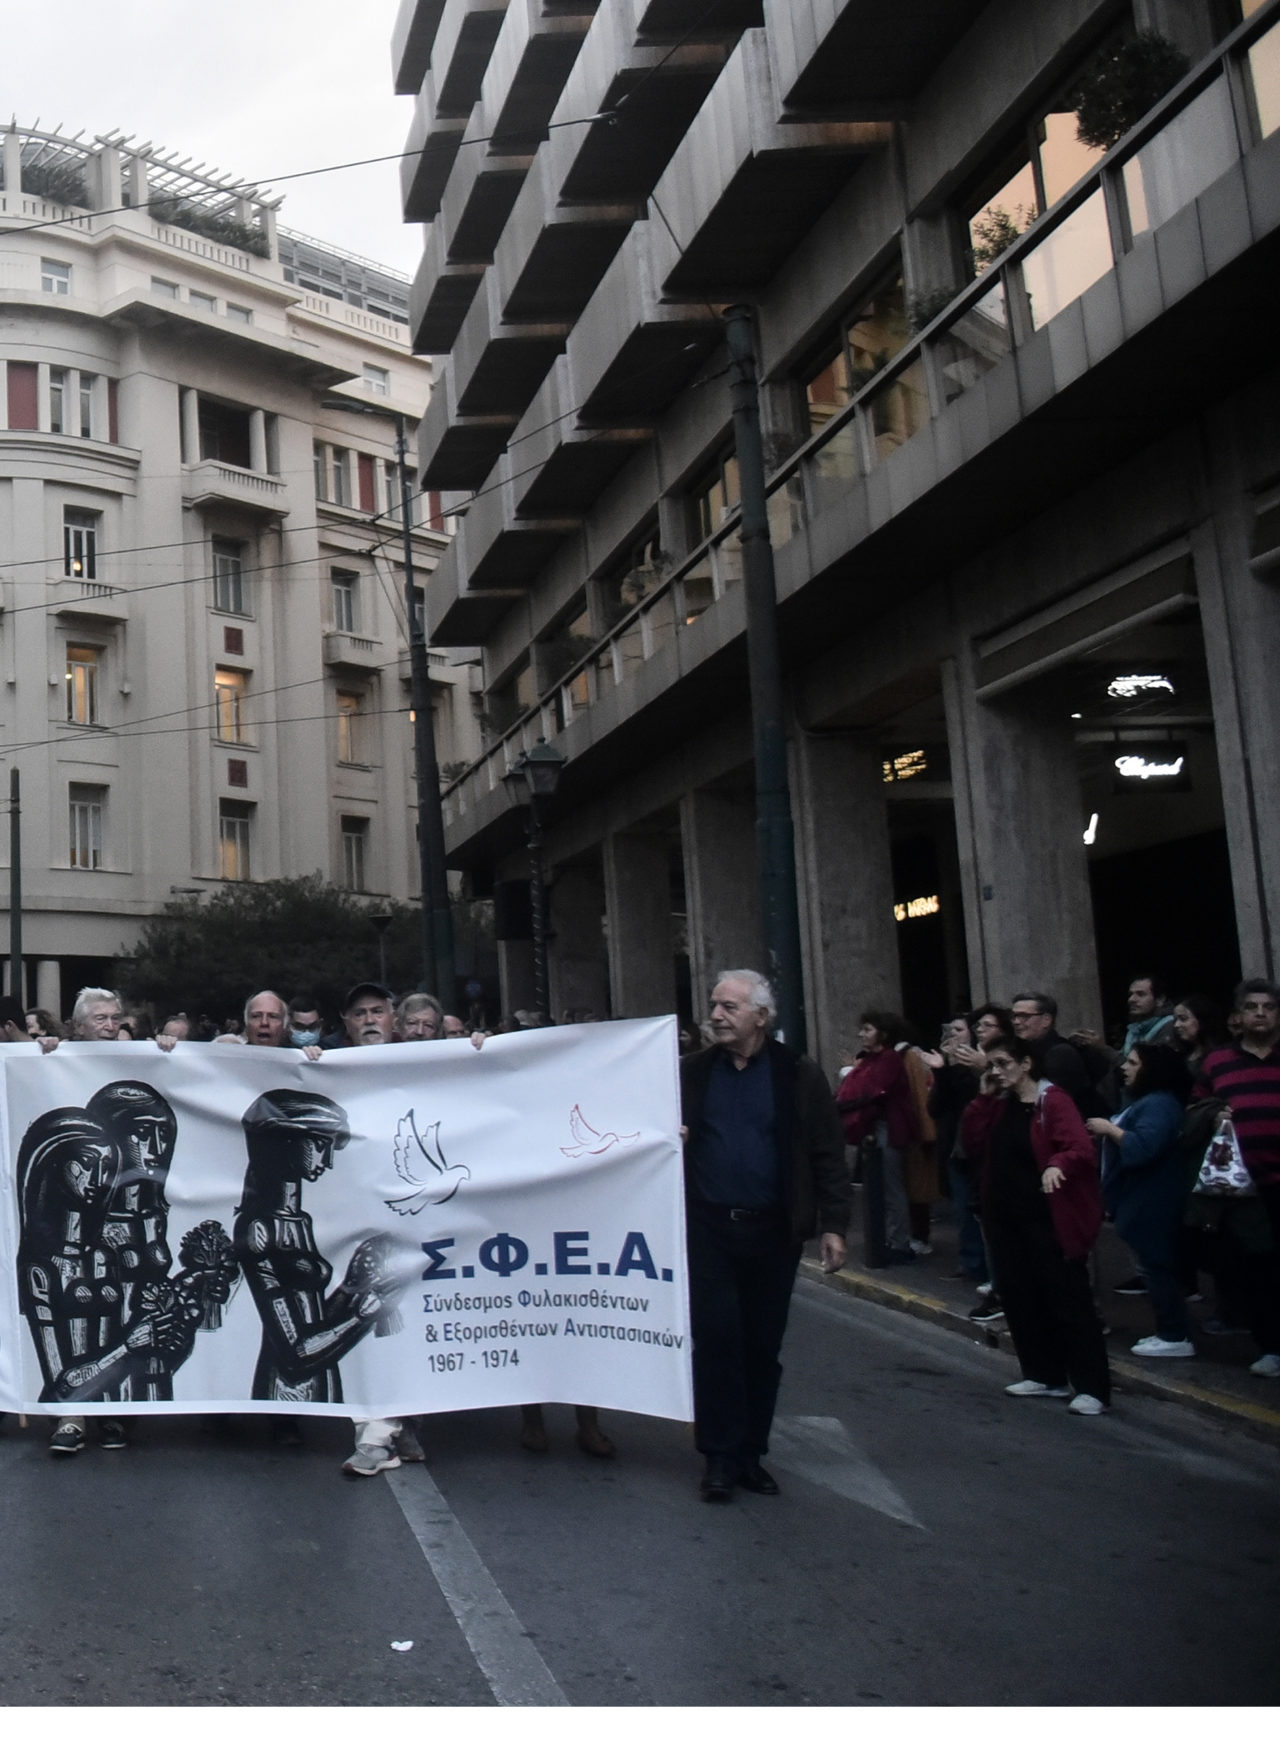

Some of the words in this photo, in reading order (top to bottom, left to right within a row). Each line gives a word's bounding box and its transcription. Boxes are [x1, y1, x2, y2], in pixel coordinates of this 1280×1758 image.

[421, 1230, 674, 1282] Σ.Φ.Ε.Α.
[423, 1292, 512, 1314] Σύνδεσμος
[517, 1288, 649, 1313] Φυλακισθέντων
[425, 1324, 438, 1343] &
[443, 1319, 558, 1344] Εξορισθέντων
[564, 1318, 684, 1350] Αντιστασιακών
[428, 1352, 464, 1373] 1967
[482, 1349, 520, 1369] 1974
